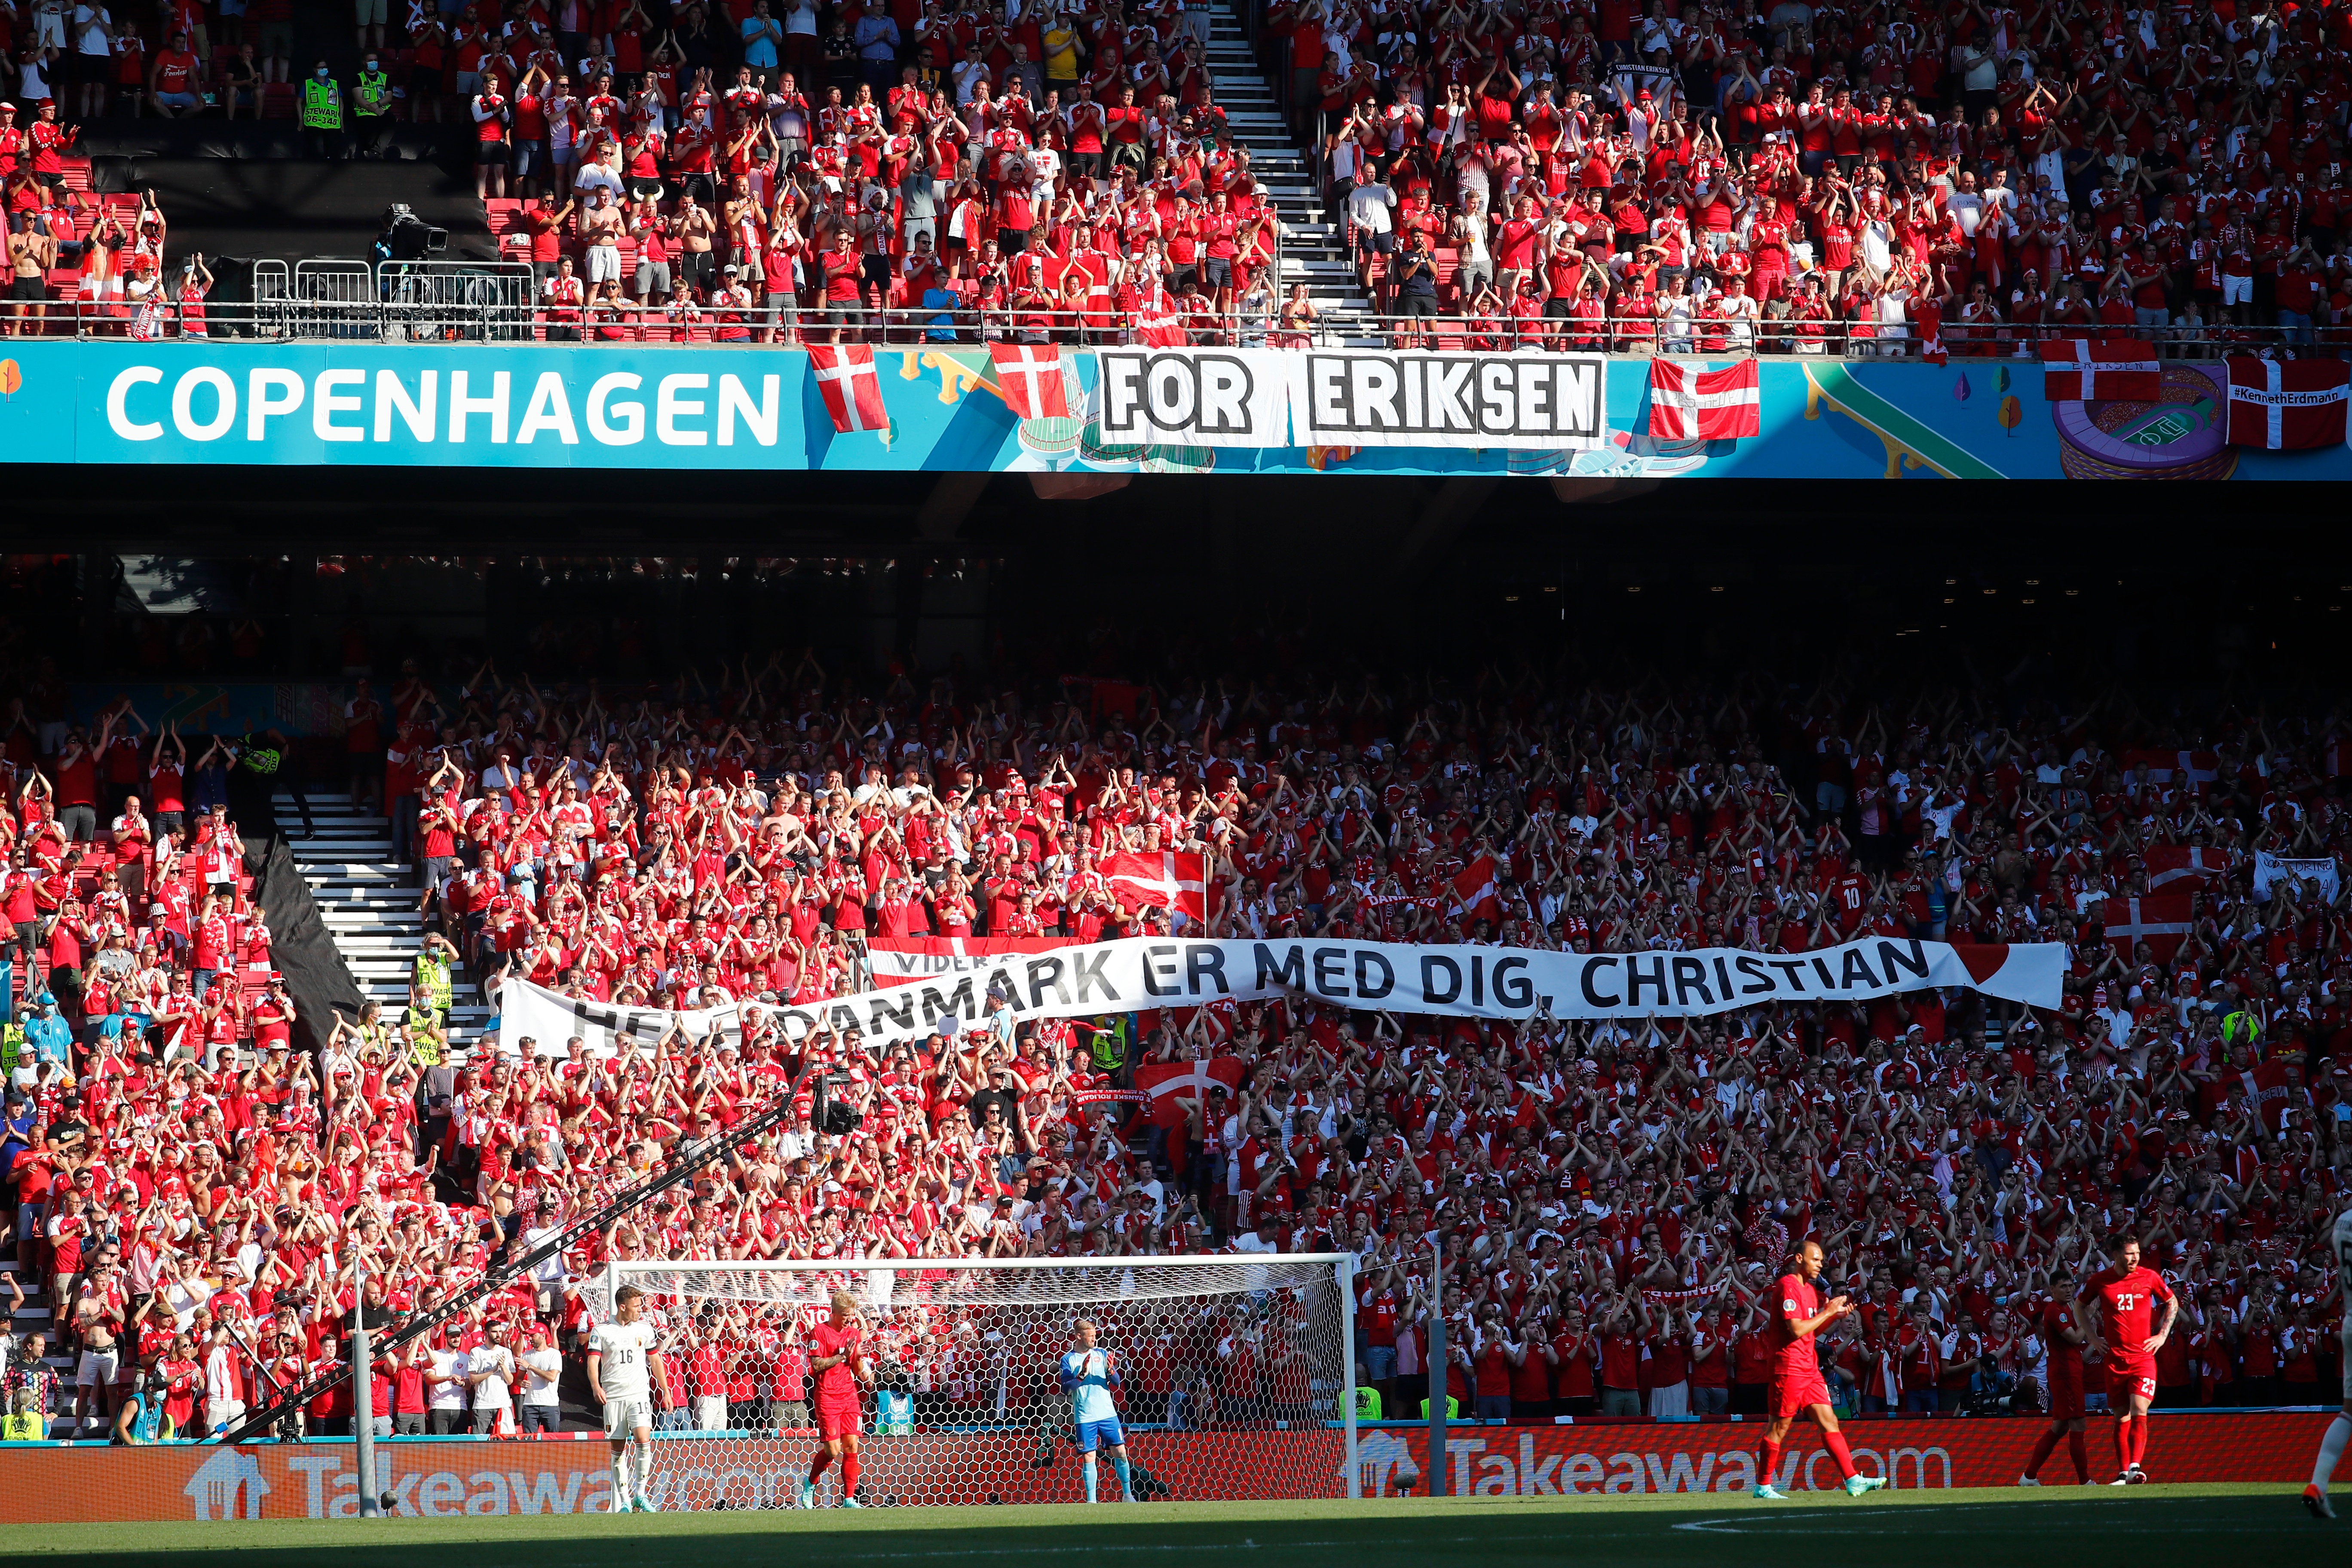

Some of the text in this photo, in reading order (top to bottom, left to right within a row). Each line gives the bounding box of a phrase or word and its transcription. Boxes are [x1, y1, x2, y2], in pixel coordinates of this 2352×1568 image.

[1615, 64, 1670, 74] CHRISTIAN ERIKSEN
[2086, 60, 2094, 69] 10
[164, 68, 187, 77] Fearless
[602, 106, 609, 116] 10
[59, 217, 65, 225] 9
[563, 290, 567, 300] 9
[2072, 362, 2143, 371] ERIKSEN
[1102, 353, 1253, 434] FOR
[1307, 355, 1603, 438] ERIKSEN
[2234, 388, 2338, 405] #KennethErdmann
[107, 365, 780, 446] COPENHAGEN
[2283, 860, 2333, 872] EDRING
[1842, 878, 1858, 886] ERIKSEN
[1907, 884, 1920, 892] DEN
[1844, 887, 1860, 910] 10
[894, 954, 1028, 973] VIDEB
[774, 949, 1121, 1046] DANMARK
[1142, 945, 1229, 996] ER
[1253, 943, 1395, 999] MED
[1580, 940, 1929, 1008] CHRISTIAN
[1076, 1094, 1112, 1104] ROLIGANS
[1114, 1094, 1145, 1102] DANSKE
[1308, 1143, 1314, 1154] 9
[2117, 1293, 2134, 1311] 23
[807, 1309, 830, 1326] 10
[619, 1350, 633, 1364] 16
[175, 1377, 183, 1387] 8
[2141, 1377, 2156, 1396] 23
[637, 1402, 650, 1415] 16
[289, 1451, 833, 1518] Takeawacom
